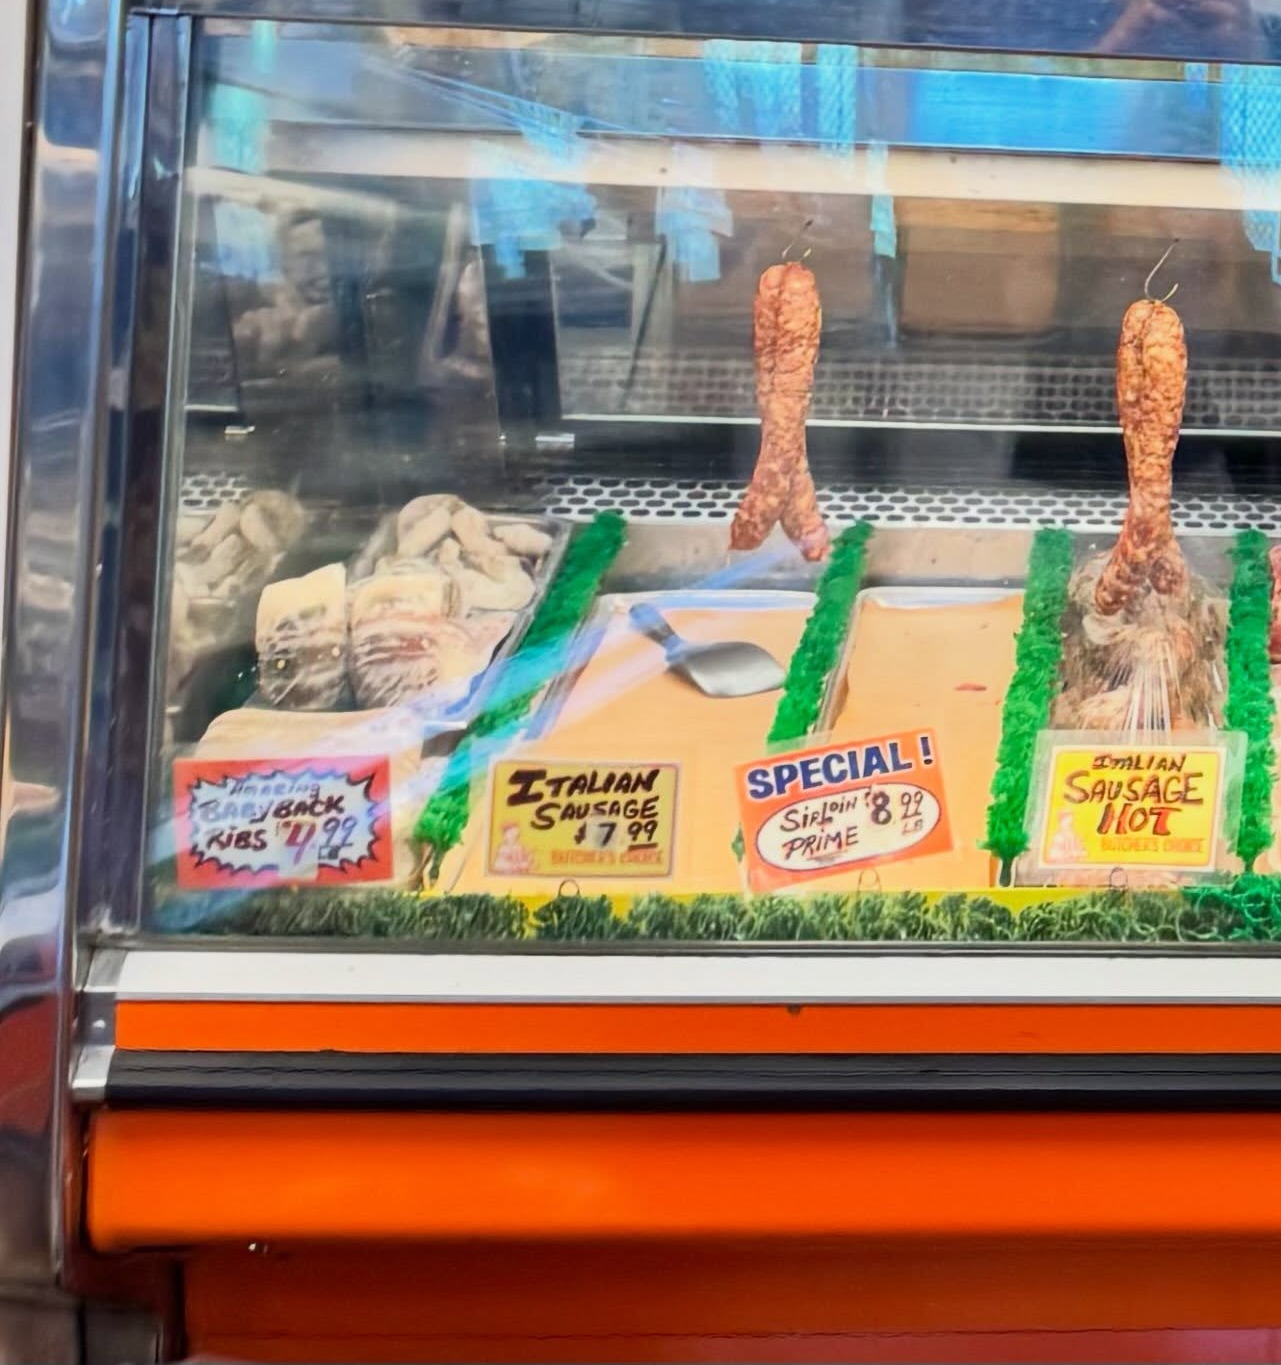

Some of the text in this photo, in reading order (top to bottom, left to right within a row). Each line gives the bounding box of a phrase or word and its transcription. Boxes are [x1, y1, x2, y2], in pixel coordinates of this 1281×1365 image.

[1092, 753, 1186, 771] ITALIAN
[507, 769, 660, 807] ITALIAN
[1064, 770, 1204, 805] SAUSAGE
[531, 796, 659, 830] SAUSAGE
[1096, 802, 1183, 836] HOT
